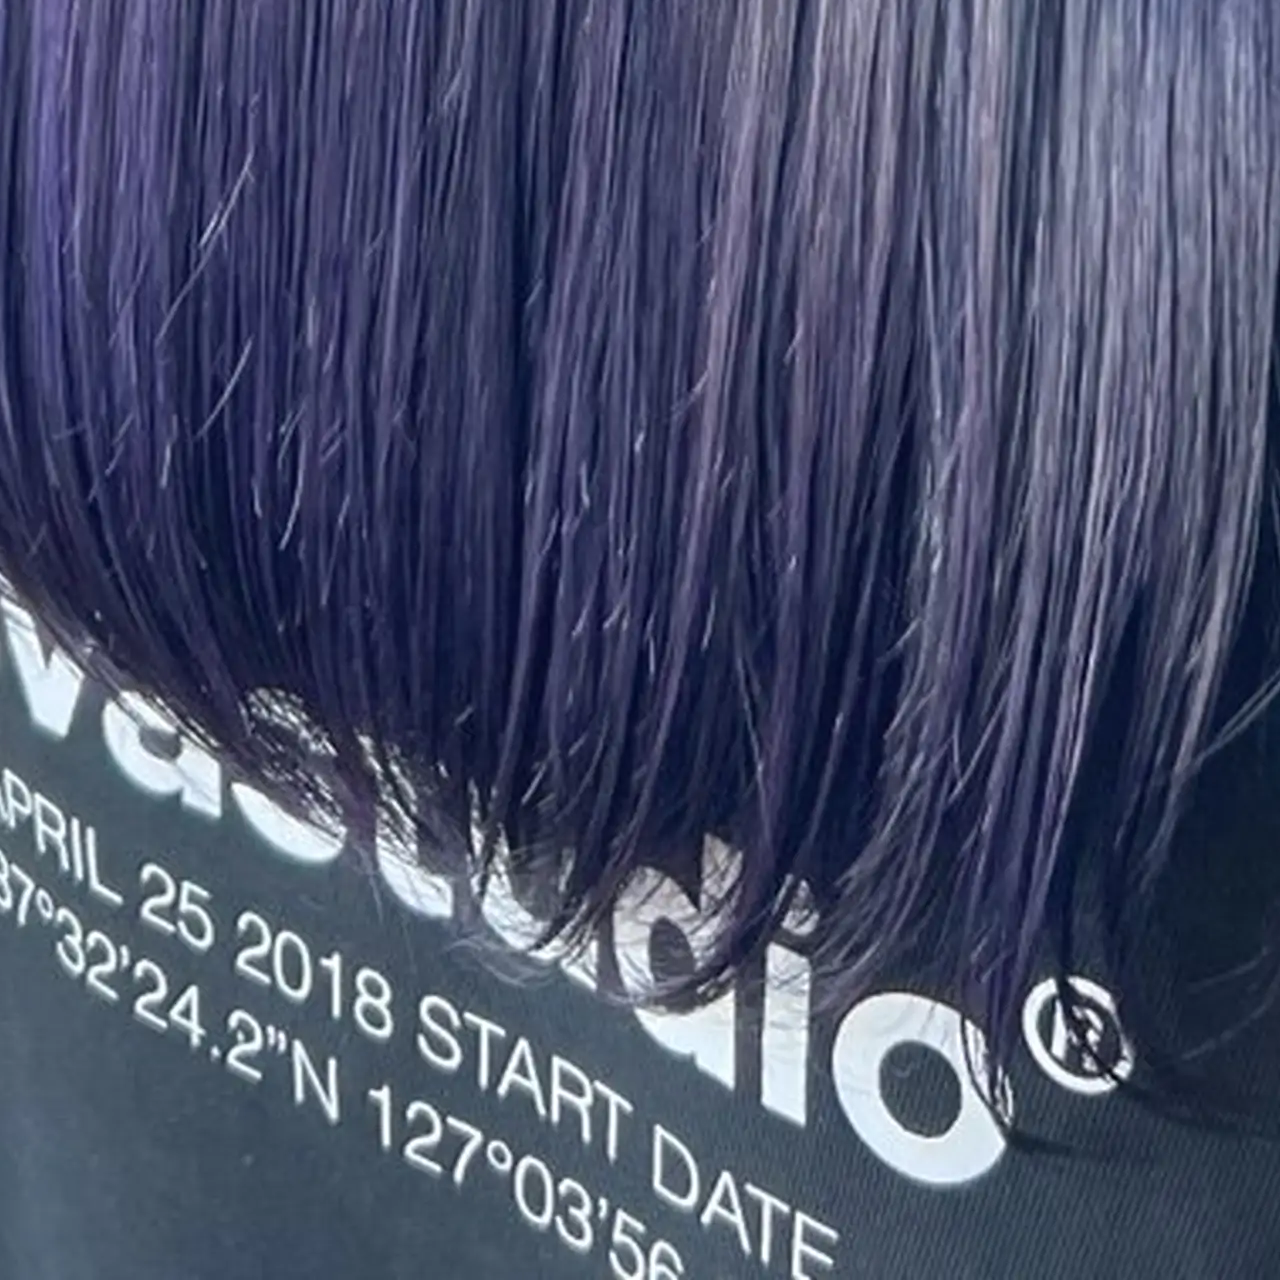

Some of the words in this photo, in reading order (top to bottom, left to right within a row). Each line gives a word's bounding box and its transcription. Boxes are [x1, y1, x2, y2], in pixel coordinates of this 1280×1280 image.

[139, 862, 216, 952] 25
[235, 910, 394, 1039] 2018
[417, 994, 634, 1165] START
[653, 1122, 840, 1280] DATE
